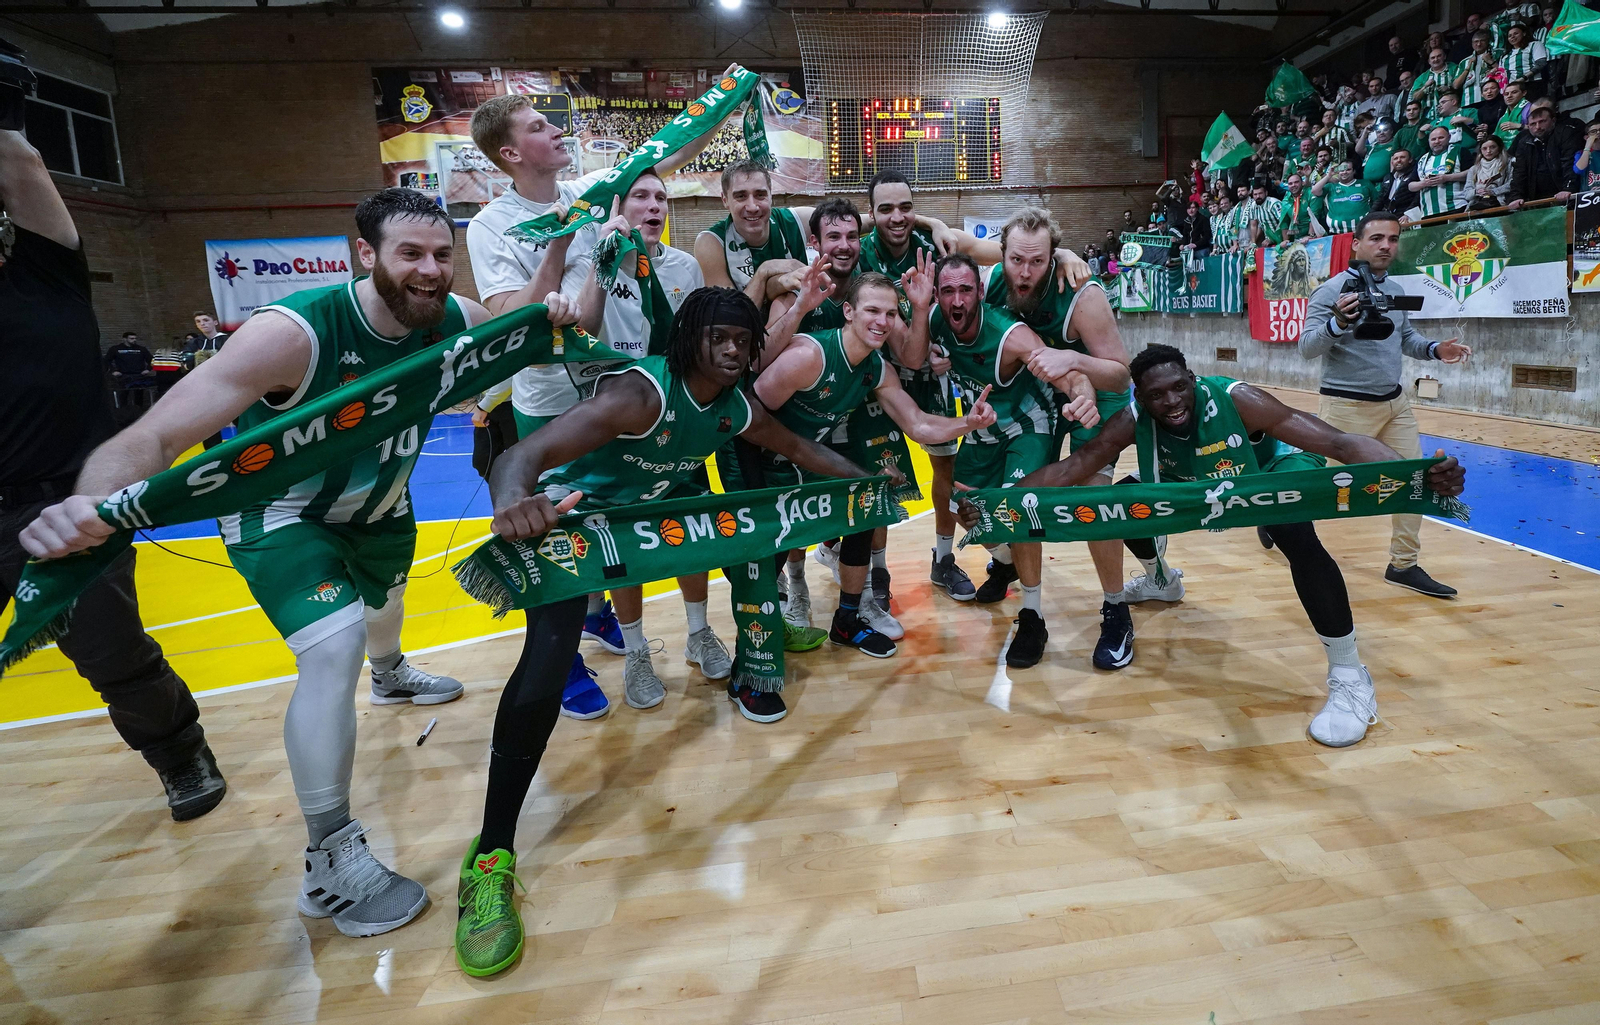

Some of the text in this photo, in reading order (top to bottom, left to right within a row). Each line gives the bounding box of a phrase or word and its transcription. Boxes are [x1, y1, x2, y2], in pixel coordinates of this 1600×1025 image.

[601, 146, 650, 184] ACB
[1133, 234, 1171, 247] SURRENDER
[1423, 278, 1454, 301] Torrejón
[1192, 294, 1217, 308] BASKET
[1269, 298, 1306, 321] FON
[1513, 305, 1566, 314] HACEMOS BETIS
[1543, 296, 1565, 306] PEÑA
[456, 325, 530, 379] ACB
[375, 424, 419, 464] 10
[639, 480, 670, 501] 3
[1224, 490, 1303, 509] ACB
[789, 492, 832, 525] ACB
[505, 568, 523, 587] plus
[745, 647, 774, 660] RealBetis
